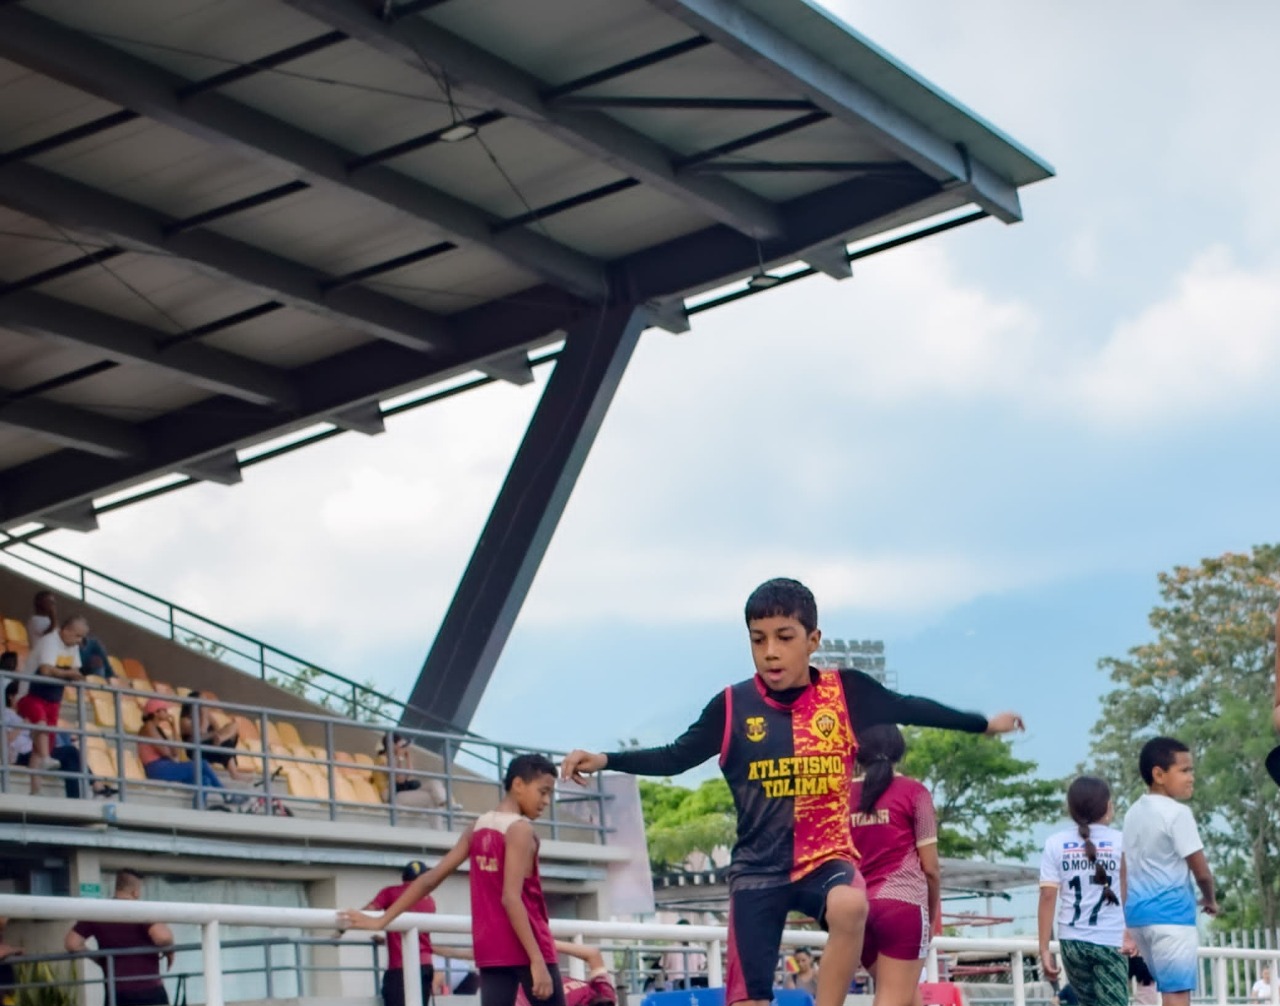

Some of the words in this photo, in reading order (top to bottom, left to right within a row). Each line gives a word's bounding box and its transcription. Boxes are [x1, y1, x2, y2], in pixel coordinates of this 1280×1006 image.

[748, 756, 842, 780] ATLETISMO
[762, 776, 829, 798] TOLIMA
[1069, 876, 1112, 926] 17
